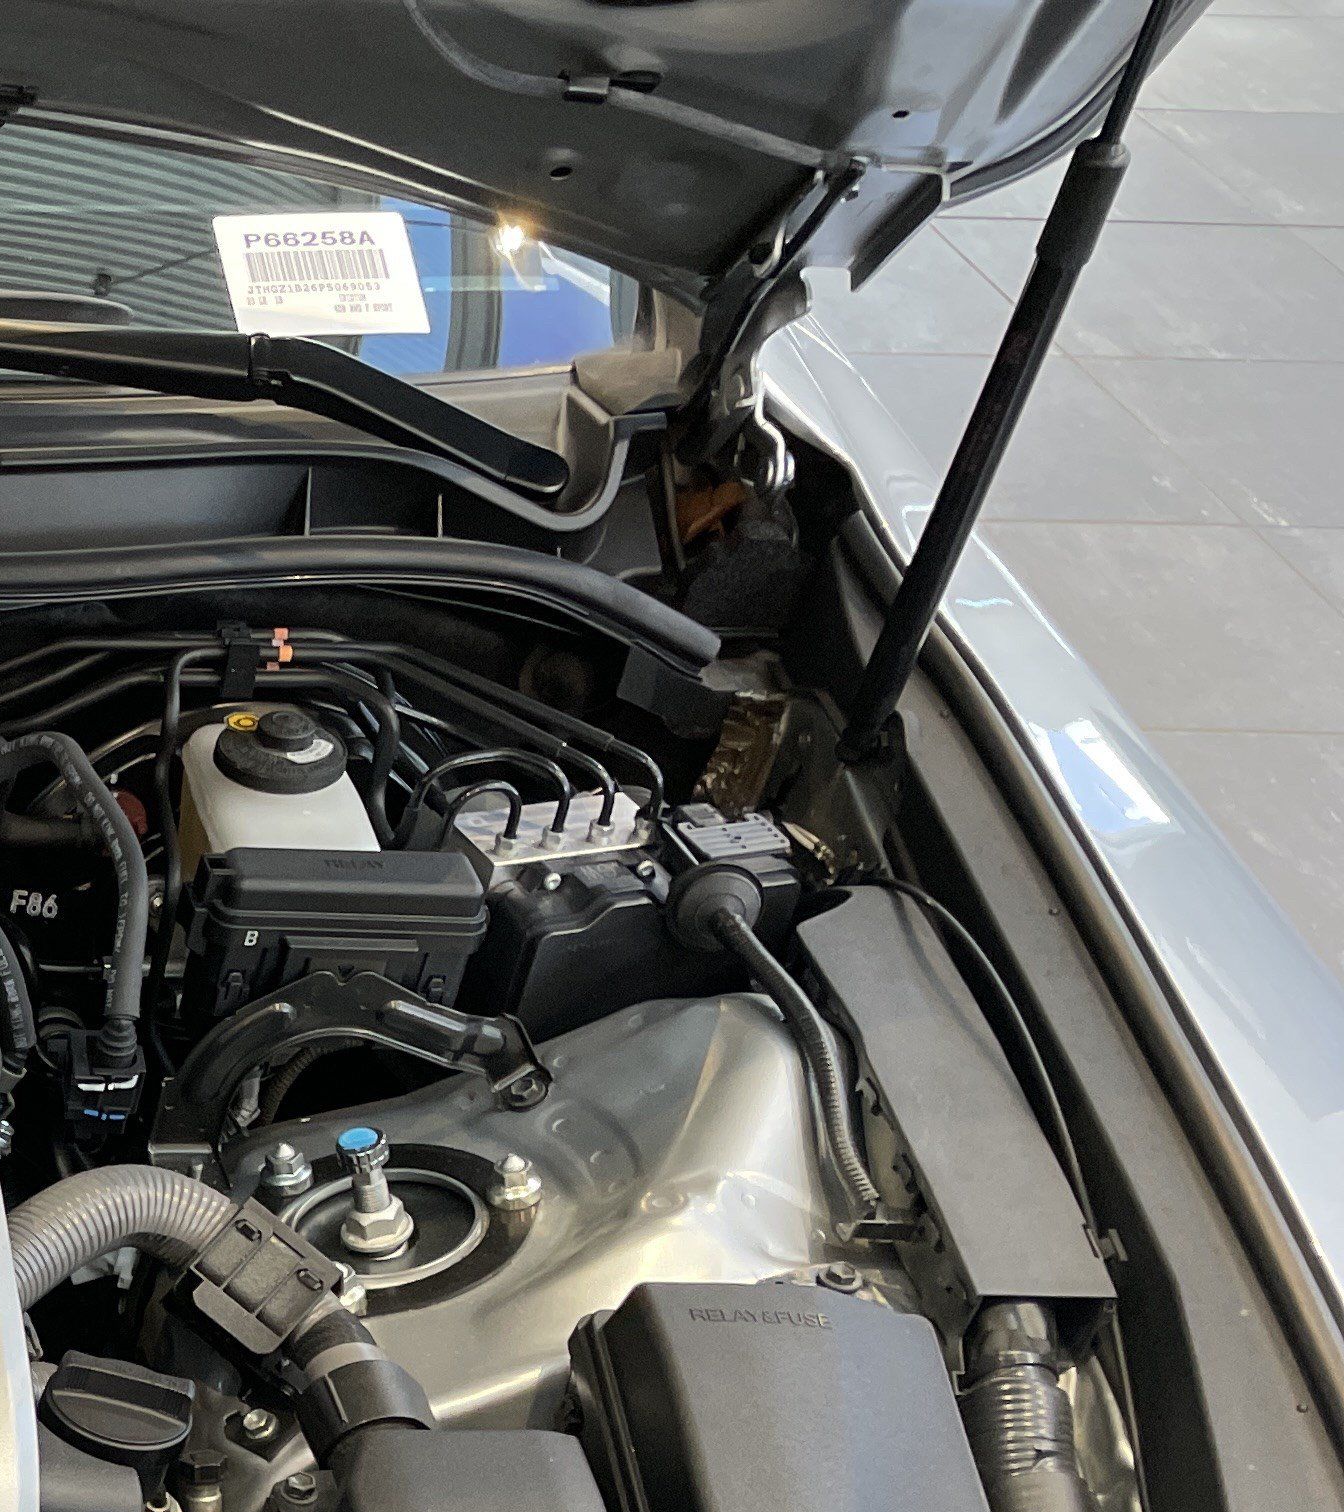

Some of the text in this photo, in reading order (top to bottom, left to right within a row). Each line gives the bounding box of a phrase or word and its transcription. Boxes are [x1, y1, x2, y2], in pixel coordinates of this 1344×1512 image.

[242, 230, 375, 249] P66258A
[9, 889, 59, 919] F86
[243, 929, 259, 947] B
